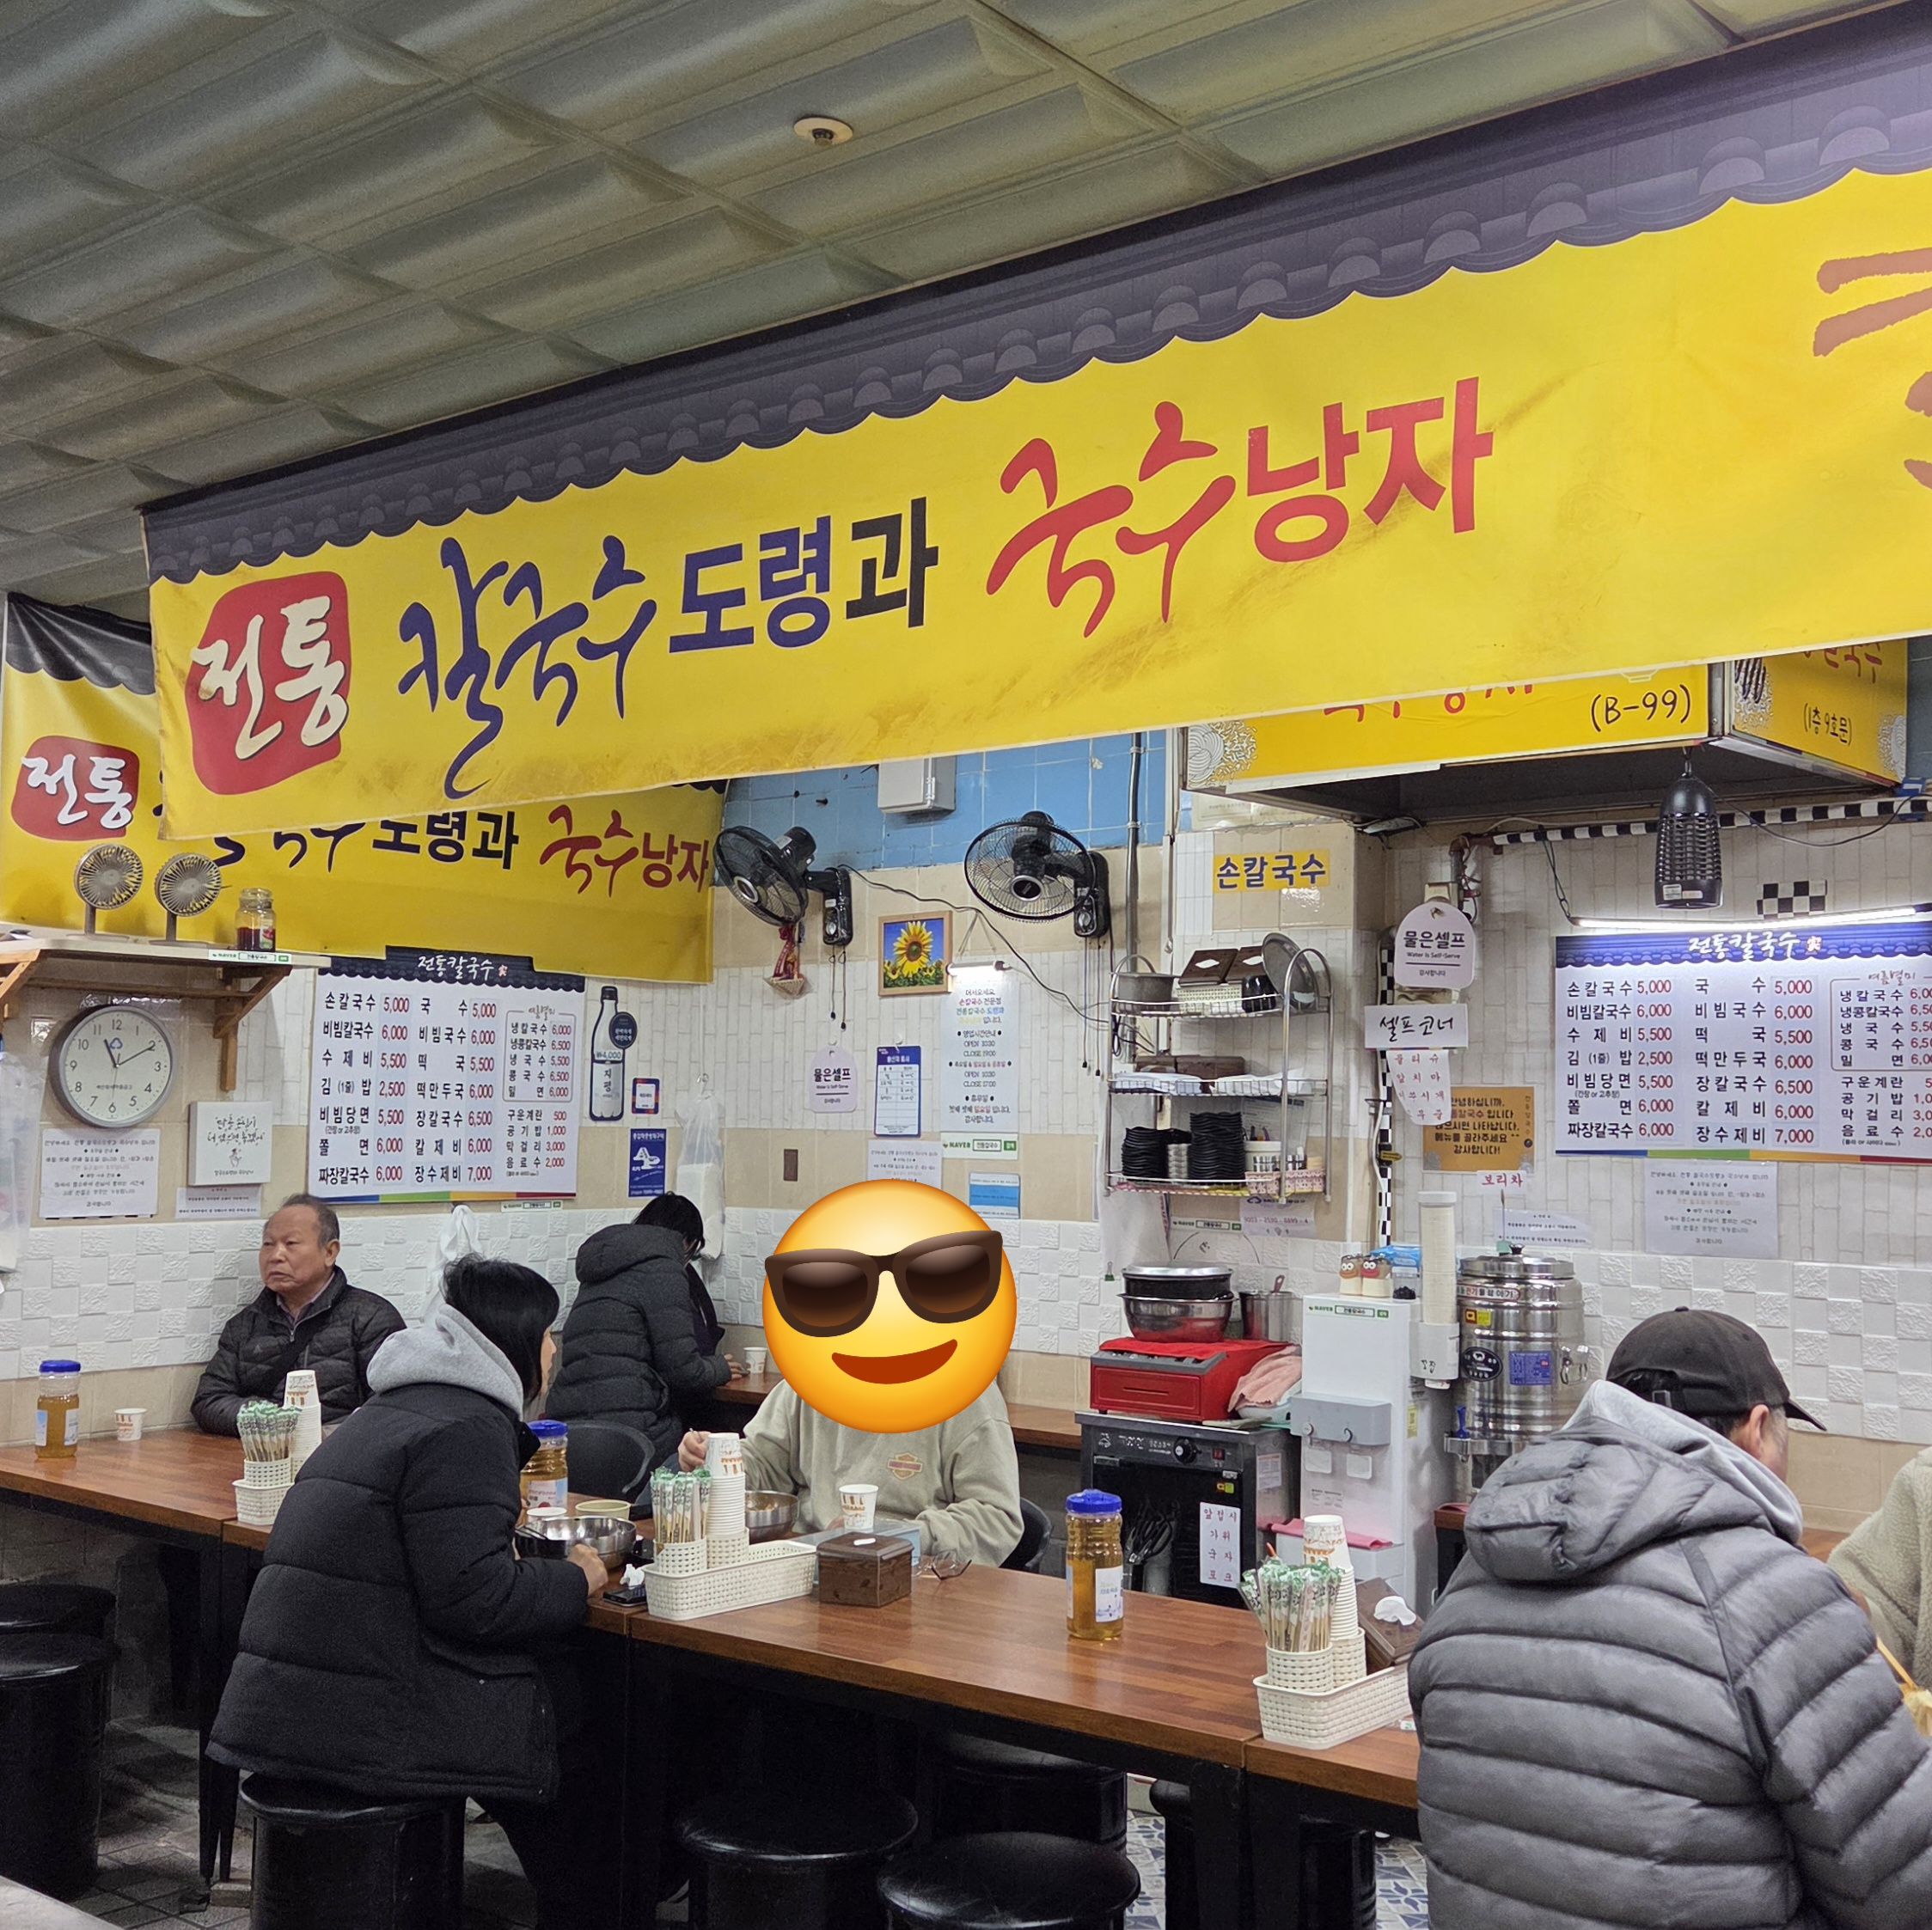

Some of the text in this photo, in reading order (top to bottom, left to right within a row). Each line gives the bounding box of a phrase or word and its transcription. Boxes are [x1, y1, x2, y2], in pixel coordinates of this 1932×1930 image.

[191, 595, 350, 761] 전통
[1590, 683, 1692, 732] (B-99)
[21, 753, 133, 830] 전통
[1216, 852, 1327, 889] 손칼국수
[1403, 931, 1465, 949] 물은셀프
[1689, 931, 1801, 960] 전통칼국수
[418, 954, 495, 981] 전통칼국수
[1567, 980, 1633, 998] 손칼국수
[1637, 979, 1672, 995] 5,000
[1774, 980, 1813, 996] 5,000
[1840, 989, 1904, 1003] 냉칼국수
[325, 992, 376, 1012] 손칼국수
[383, 997, 409, 1013] 5,000
[473, 1003, 496, 1020] 5,000
[1567, 1003, 1632, 1021] 비빔칼국수
[1636, 1003, 1672, 1019] 6,000
[1695, 1001, 1766, 1019] 비빔국수
[1774, 1005, 1813, 1021] 6,000
[93, 1023, 101, 1036] 11
[111, 1018, 122, 1031] 12
[135, 1025, 139, 1036] 1
[323, 1020, 374, 1040] 비빔칼국수
[382, 1024, 407, 1041] 6,000
[419, 1026, 467, 1045] 비빔국수
[471, 1029, 495, 1047] 6,000
[552, 1023, 572, 1036] 6,000
[1379, 1015, 1454, 1042] 셀프 코너
[77, 1038, 89, 1051] 10
[1637, 1026, 1672, 1043] 5,500
[1774, 1029, 1813, 1046] 5,500
[551, 1040, 571, 1052] 6,500
[69, 1060, 77, 1072] 9
[154, 1060, 162, 1072] 3
[380, 1053, 407, 1070] 5,500
[470, 1056, 494, 1073] 5,500
[550, 1055, 571, 1067] 5,500
[1637, 1050, 1673, 1066] 2,500
[1695, 1051, 1767, 1068] 떡만두국
[1774, 1054, 1814, 1071] 6,000
[549, 1071, 570, 1083] 6,500
[813, 1067, 852, 1083] 물은셀프
[1567, 1072, 1904, 1095] 비빔당면 5,500 장칼국수 6,500 구운계란
[74, 1081, 83, 1093] 8
[144, 1082, 152, 1094] 4
[379, 1080, 406, 1098] 2,500
[417, 1082, 464, 1101] 떡만두국
[469, 1084, 493, 1101] 6,000
[548, 1086, 569, 1098] 6,000
[89, 1095, 99, 1108] 7
[108, 1102, 116, 1114] 6
[129, 1095, 138, 1107] 5
[1638, 1098, 1674, 1114] 6,000
[1775, 1104, 1814, 1121] 6,000
[320, 1106, 370, 1124] 비빔당면
[377, 1109, 404, 1127] 5,500
[416, 1109, 463, 1128] 장칼국수
[468, 1110, 492, 1128] 6,500
[553, 1110, 567, 1121] 500
[1452, 1109, 1514, 1120] 통칼국수 입니다
[547, 1125, 566, 1136] 1,000
[1567, 1121, 1634, 1139] 짜장칼국수
[1638, 1122, 1675, 1138] 6,000
[1696, 1126, 1766, 1145] 장수제비
[1775, 1128, 1815, 1145] 7,000
[376, 1137, 403, 1155] 6,000
[468, 1137, 492, 1155] 6,000
[545, 1141, 566, 1152] 3,000
[545, 1157, 566, 1169] 2,000
[318, 1164, 492, 1186] 짜장칼국수 6,000 장수제비 7,000
[1482, 1172, 1524, 1188] 보리차
[1210, 1529, 1231, 1542] 가위
[1208, 1569, 1232, 1582] 포크
